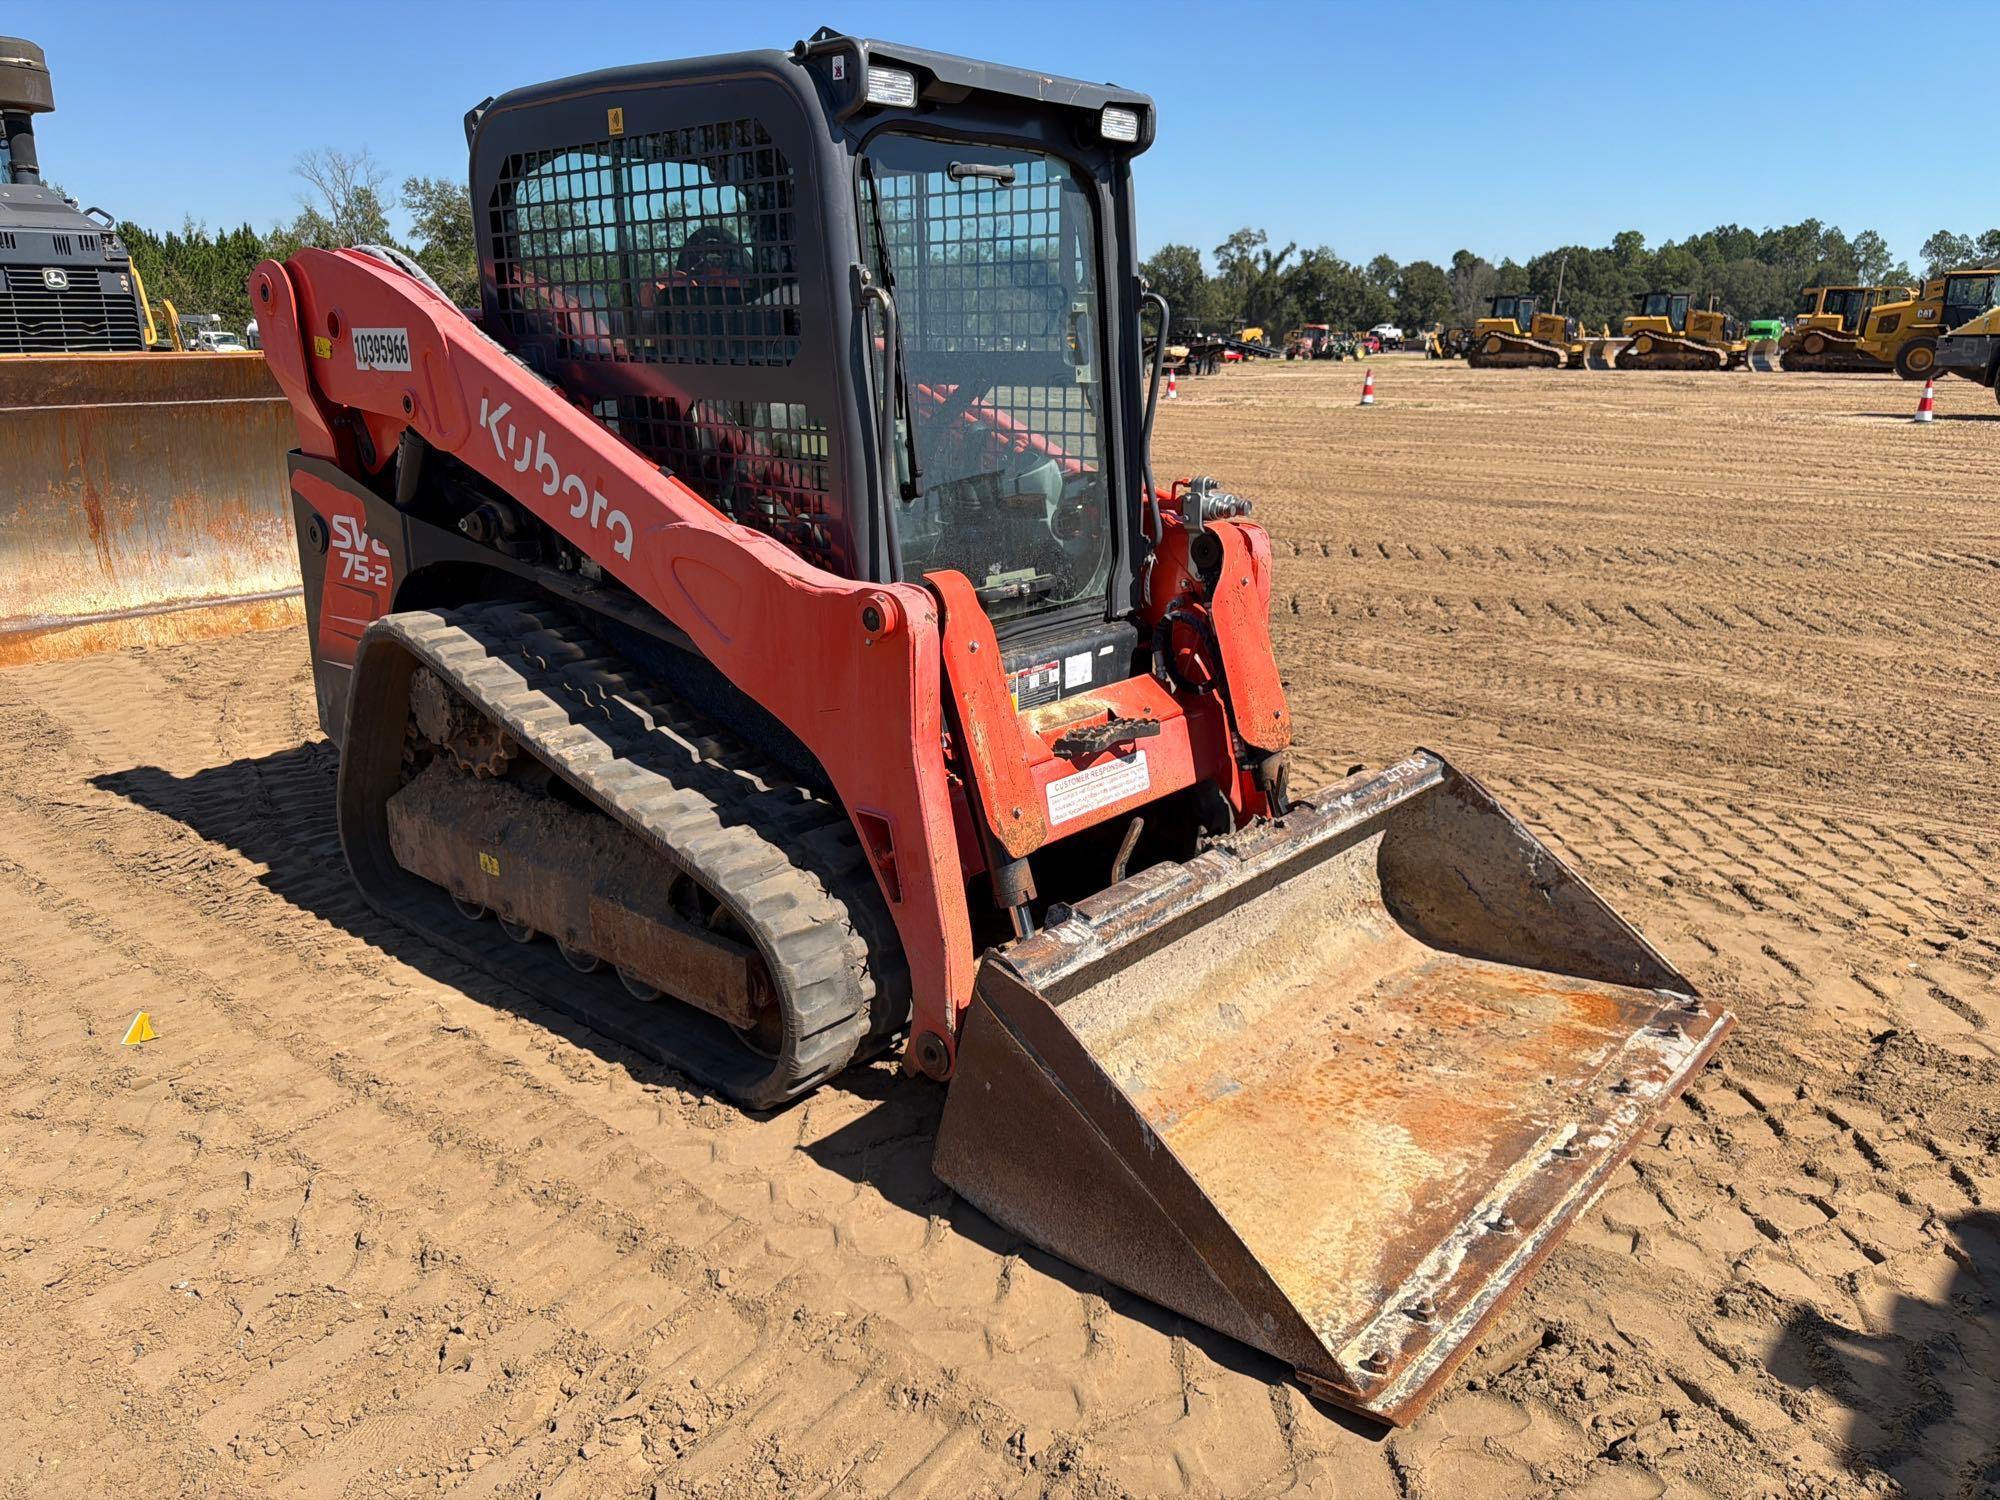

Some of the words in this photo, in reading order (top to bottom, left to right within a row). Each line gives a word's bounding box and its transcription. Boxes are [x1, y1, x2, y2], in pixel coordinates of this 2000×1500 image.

[1917, 309, 1934, 319] CAT
[354, 334, 409, 364] 10395966
[479, 398, 634, 562] Kubota
[339, 551, 387, 587] 75-2
[1054, 773, 1090, 792] CUSTOMER
